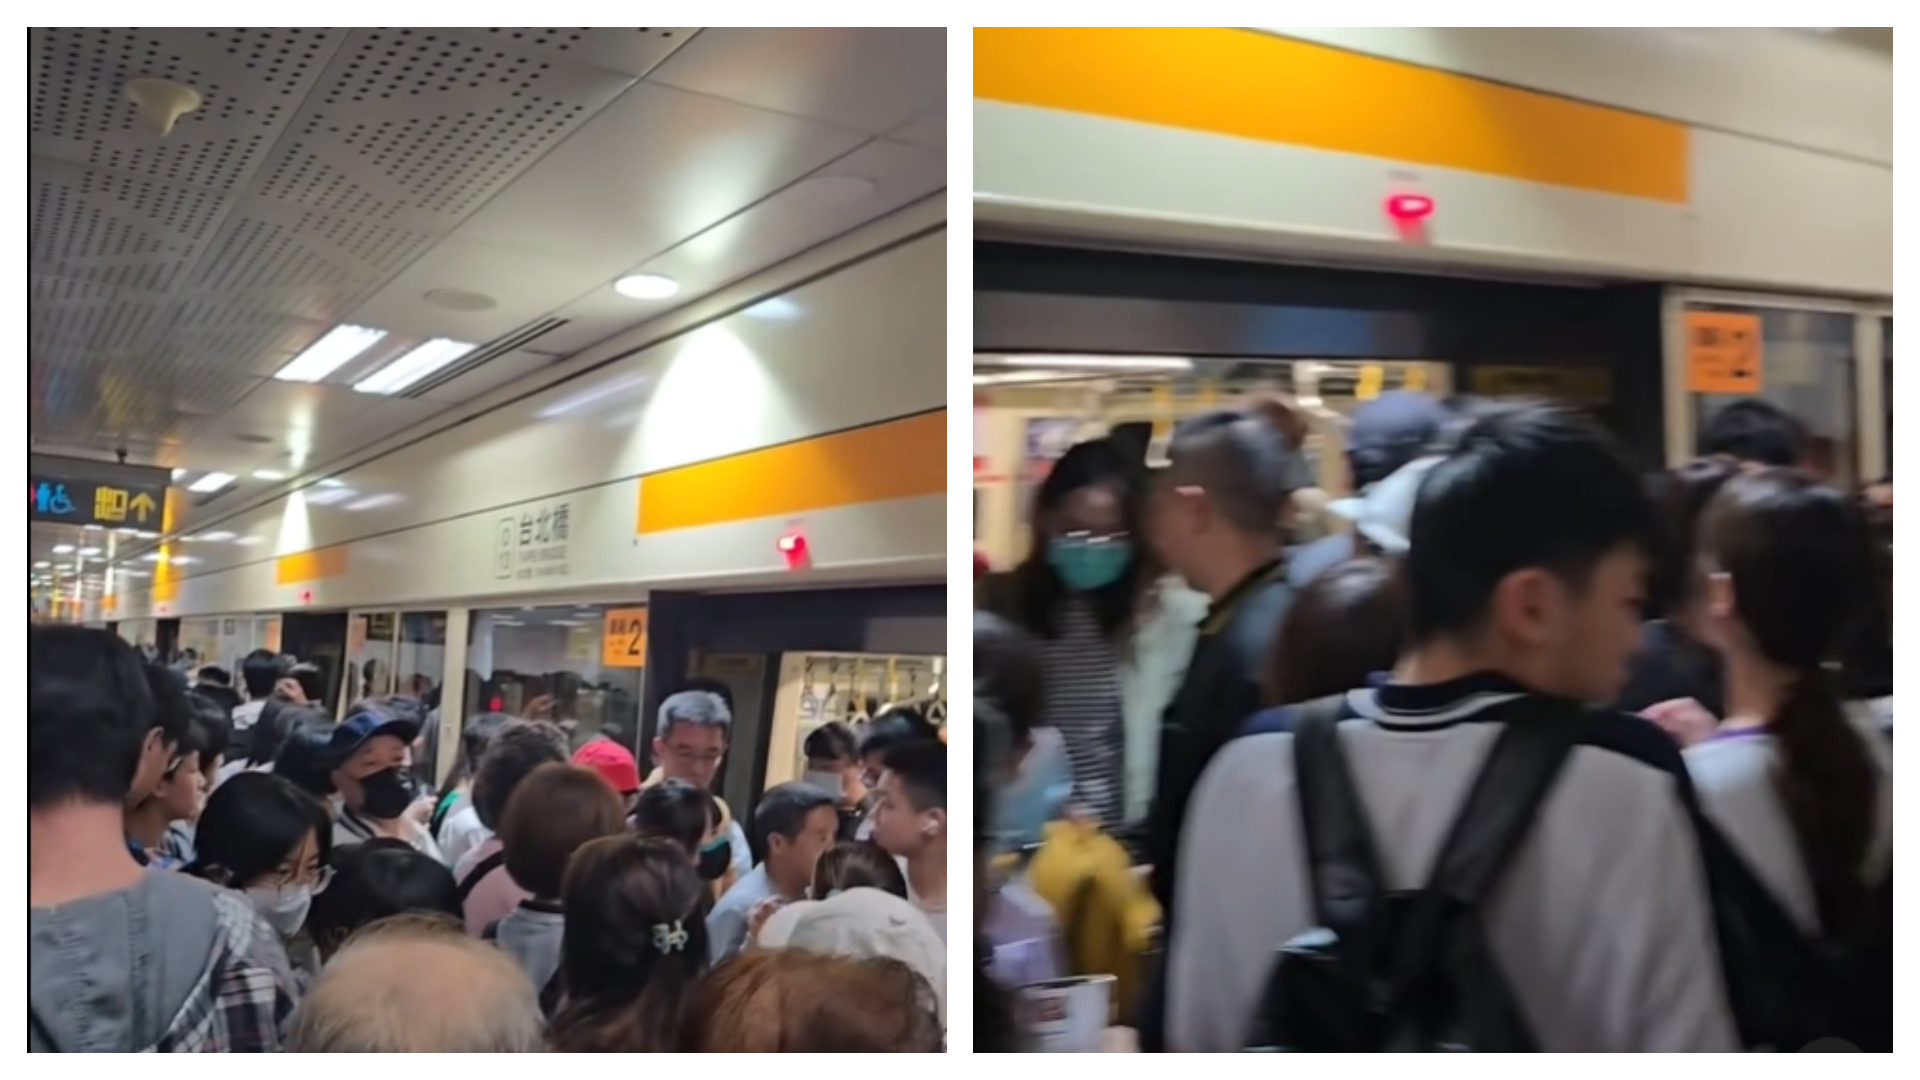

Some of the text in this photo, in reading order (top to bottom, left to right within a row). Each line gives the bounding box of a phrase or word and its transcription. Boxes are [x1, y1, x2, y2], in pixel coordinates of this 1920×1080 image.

[1728, 330, 1758, 379] 2
[94, 486, 129, 521] 出口
[519, 503, 569, 546] 台北橋
[628, 618, 642, 656] 2
